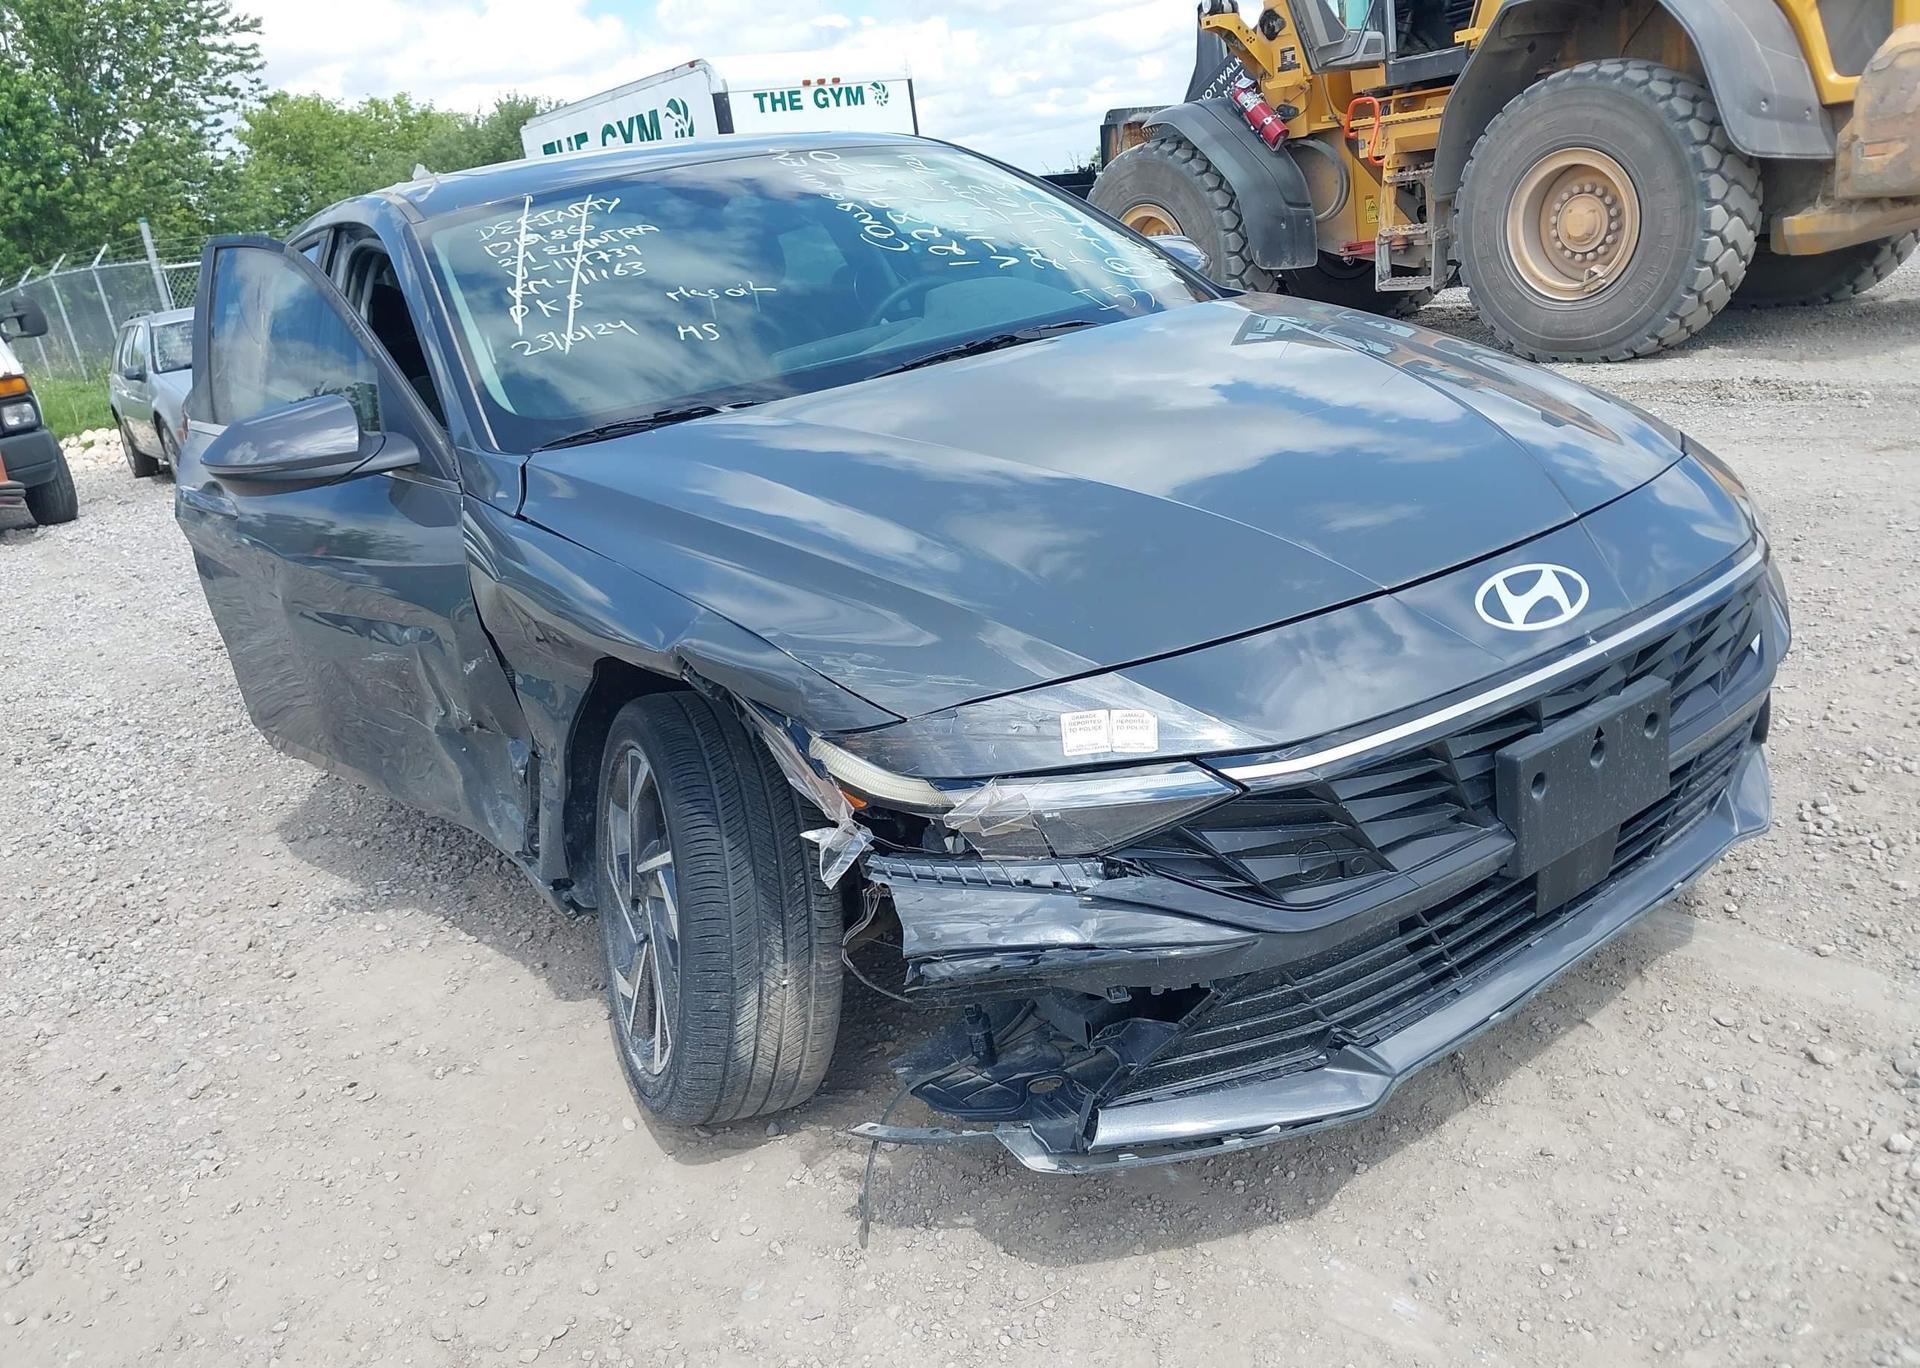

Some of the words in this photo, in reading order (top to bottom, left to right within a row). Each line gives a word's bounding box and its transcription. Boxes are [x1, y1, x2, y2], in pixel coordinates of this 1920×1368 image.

[1216, 56, 1242, 84] WALK
[753, 90, 803, 113] THE
[813, 86, 865, 109] GYM
[542, 225, 660, 255] ELANTRA
